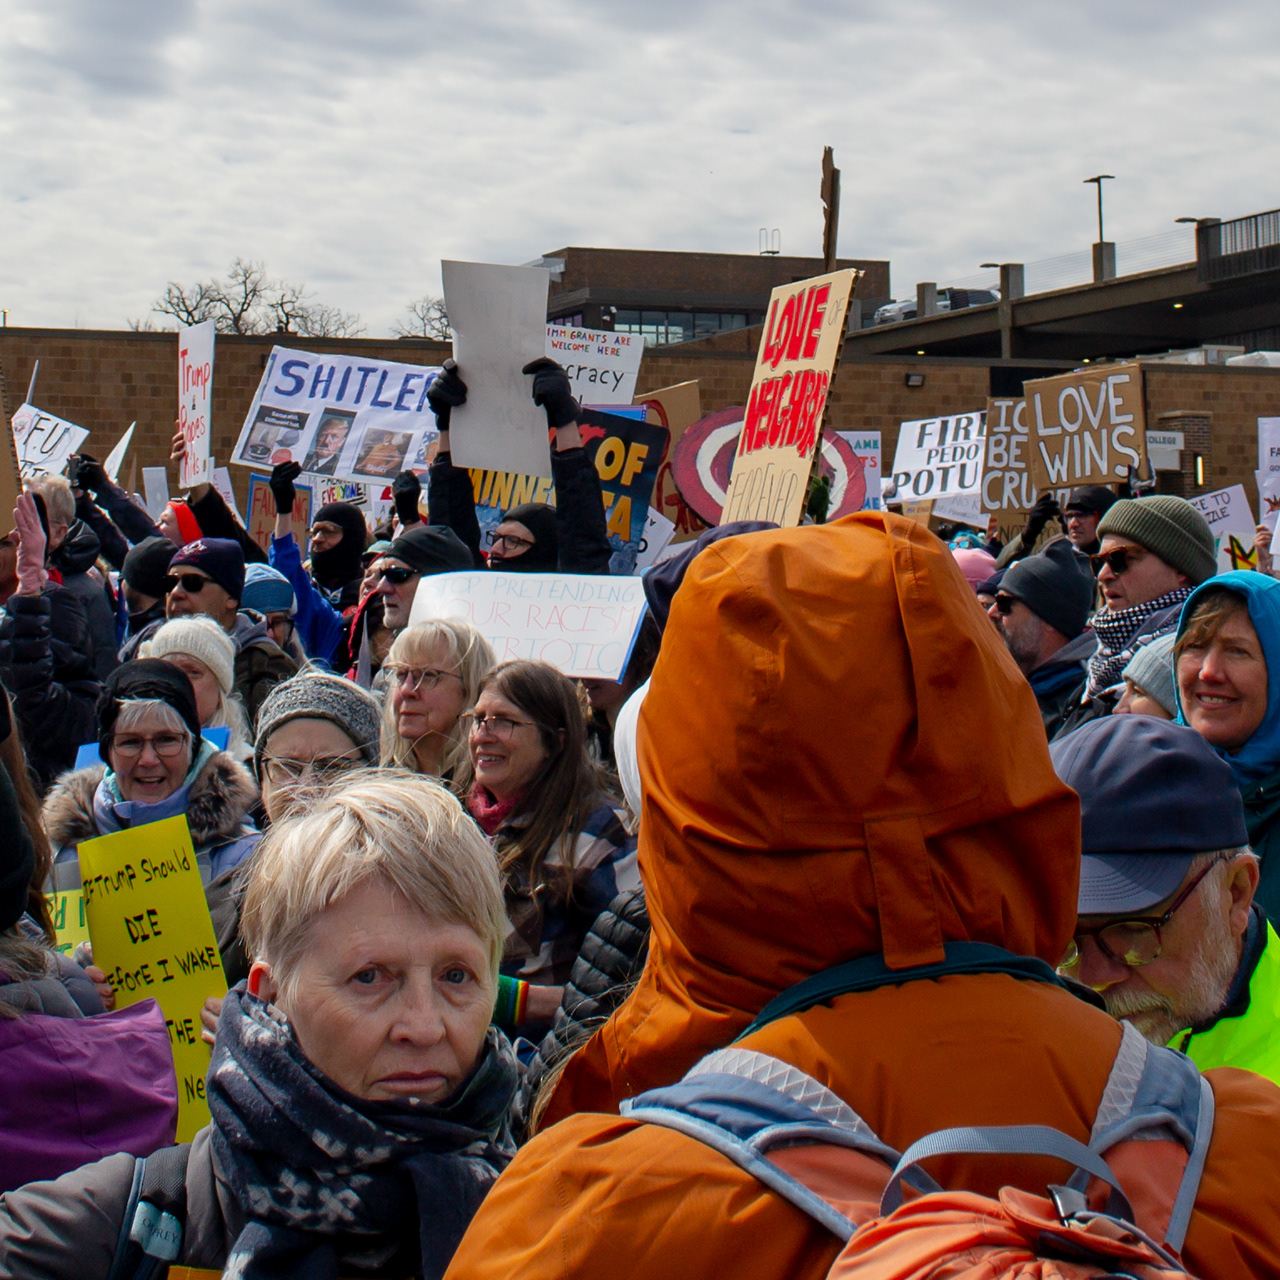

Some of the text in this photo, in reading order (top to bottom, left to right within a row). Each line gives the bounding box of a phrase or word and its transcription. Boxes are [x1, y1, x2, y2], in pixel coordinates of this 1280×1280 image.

[547, 327, 631, 346] IMMIGRANTS ARE
[761, 282, 832, 370] LOVE
[551, 340, 621, 356] WELCOME HERE
[180, 348, 210, 400] Trump
[566, 364, 624, 392] cracy
[1033, 374, 1134, 436] LOVE
[927, 443, 979, 465] PEDO
[1038, 424, 1140, 484] WINS
[1147, 436, 1177, 445] OLLEGE
[595, 436, 649, 486] OF
[892, 461, 978, 496] POTU
[322, 482, 367, 506] EVERYONE!
[1210, 491, 1231, 506] TO
[1206, 506, 1230, 524] ZZLE
[426, 576, 641, 602] STOP PRETENDING
[431, 598, 637, 635] YOUR RACISM
[488, 636, 622, 672] TRIOTIC
[125, 908, 162, 944] DIE
[158, 959, 174, 983] I
[175, 946, 220, 976] WAKE
[166, 1019, 196, 1045] THE
[185, 1075, 206, 1104] Ne
